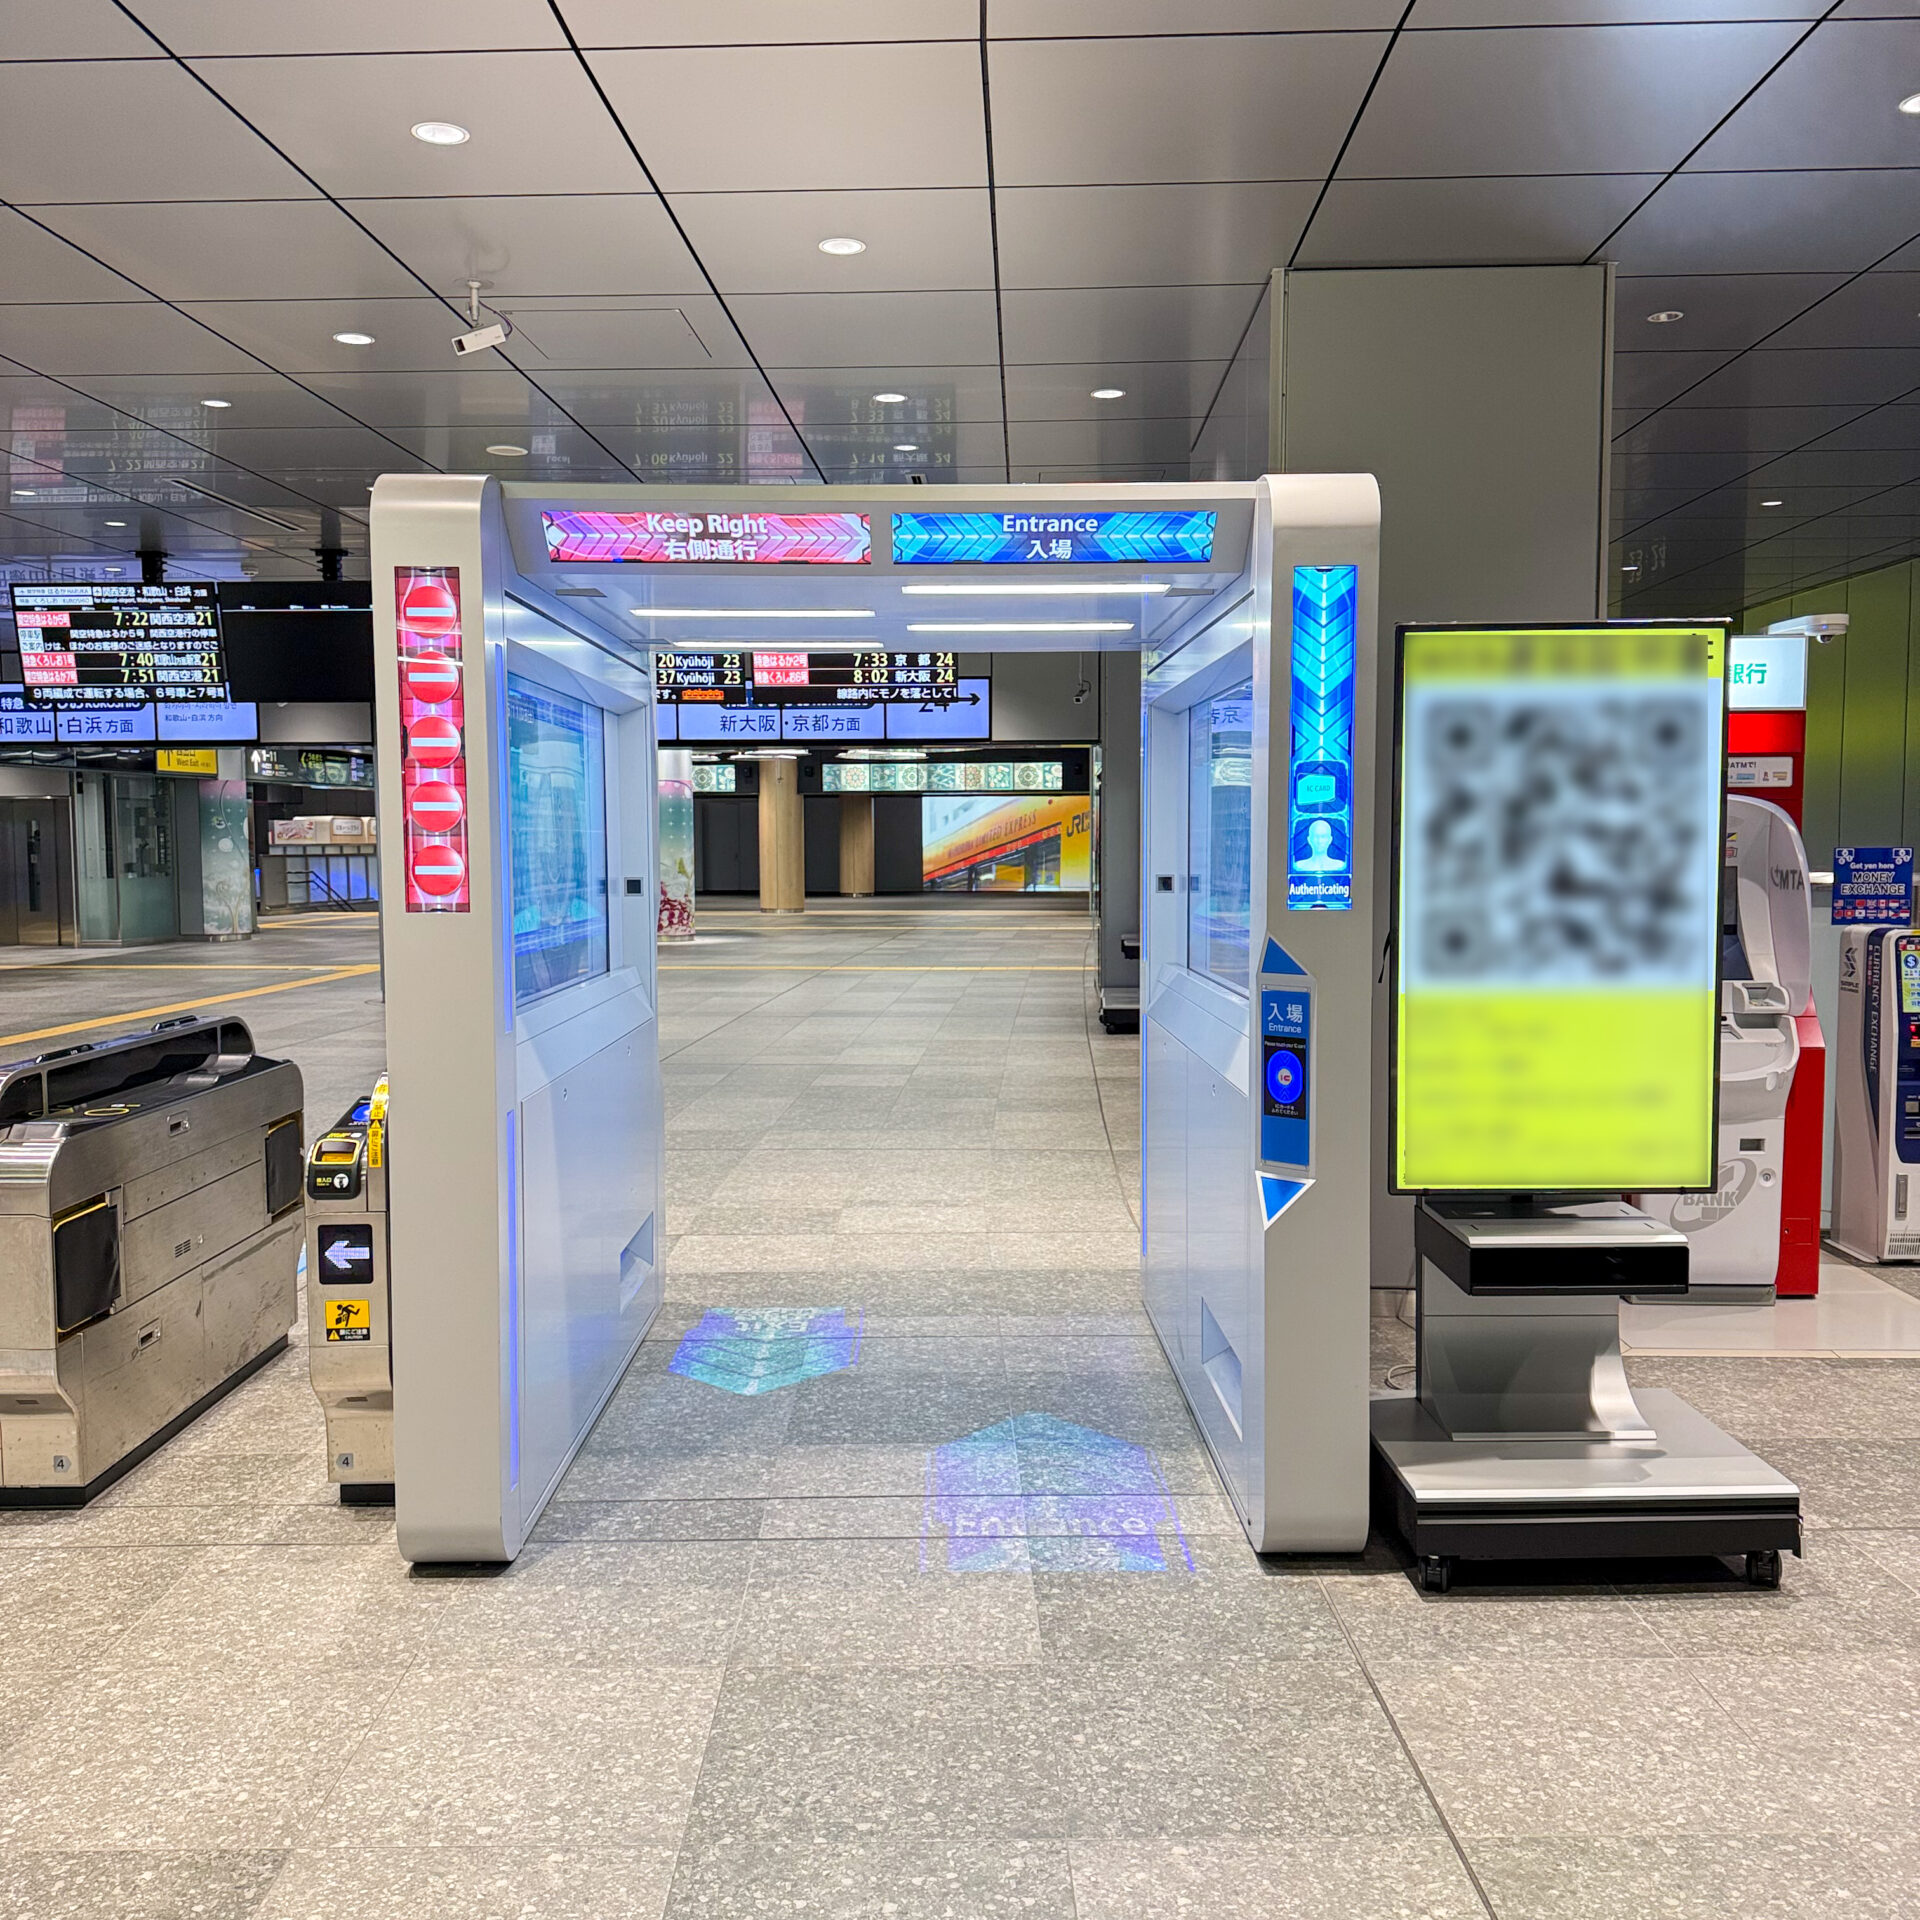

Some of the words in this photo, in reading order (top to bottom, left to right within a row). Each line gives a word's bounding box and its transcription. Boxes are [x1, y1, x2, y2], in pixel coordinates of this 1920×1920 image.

[647, 514, 704, 537] Keep
[708, 514, 768, 534] Right
[1003, 514, 1098, 532] Entrance
[664, 538, 758, 561] 右側通行
[1026, 539, 1072, 559] 入場
[113, 612, 149, 626] 7:22
[196, 612, 212, 626] 21
[119, 652, 154, 667] 7:40
[200, 652, 217, 666] 21
[723, 654, 741, 668] 23
[852, 652, 888, 667] 7:33
[936, 652, 954, 667] 24
[121, 669, 155, 683] 7:51
[202, 669, 219, 682] 21
[723, 670, 742, 685] 23
[853, 669, 889, 684] 8:02
[894, 670, 931, 683] 新大阪
[936, 669, 954, 683] 24
[1852, 871, 1895, 883] MONEY
[1289, 883, 1350, 898] Authenticating
[1840, 883, 1906, 895] EXCHANGE
[1267, 1002, 1304, 1024] 入場
[1268, 1022, 1303, 1034] Entrance
[1683, 1191, 1737, 1207] BANK
[57, 1459, 65, 1469] 4
[342, 1456, 350, 1467] 4
